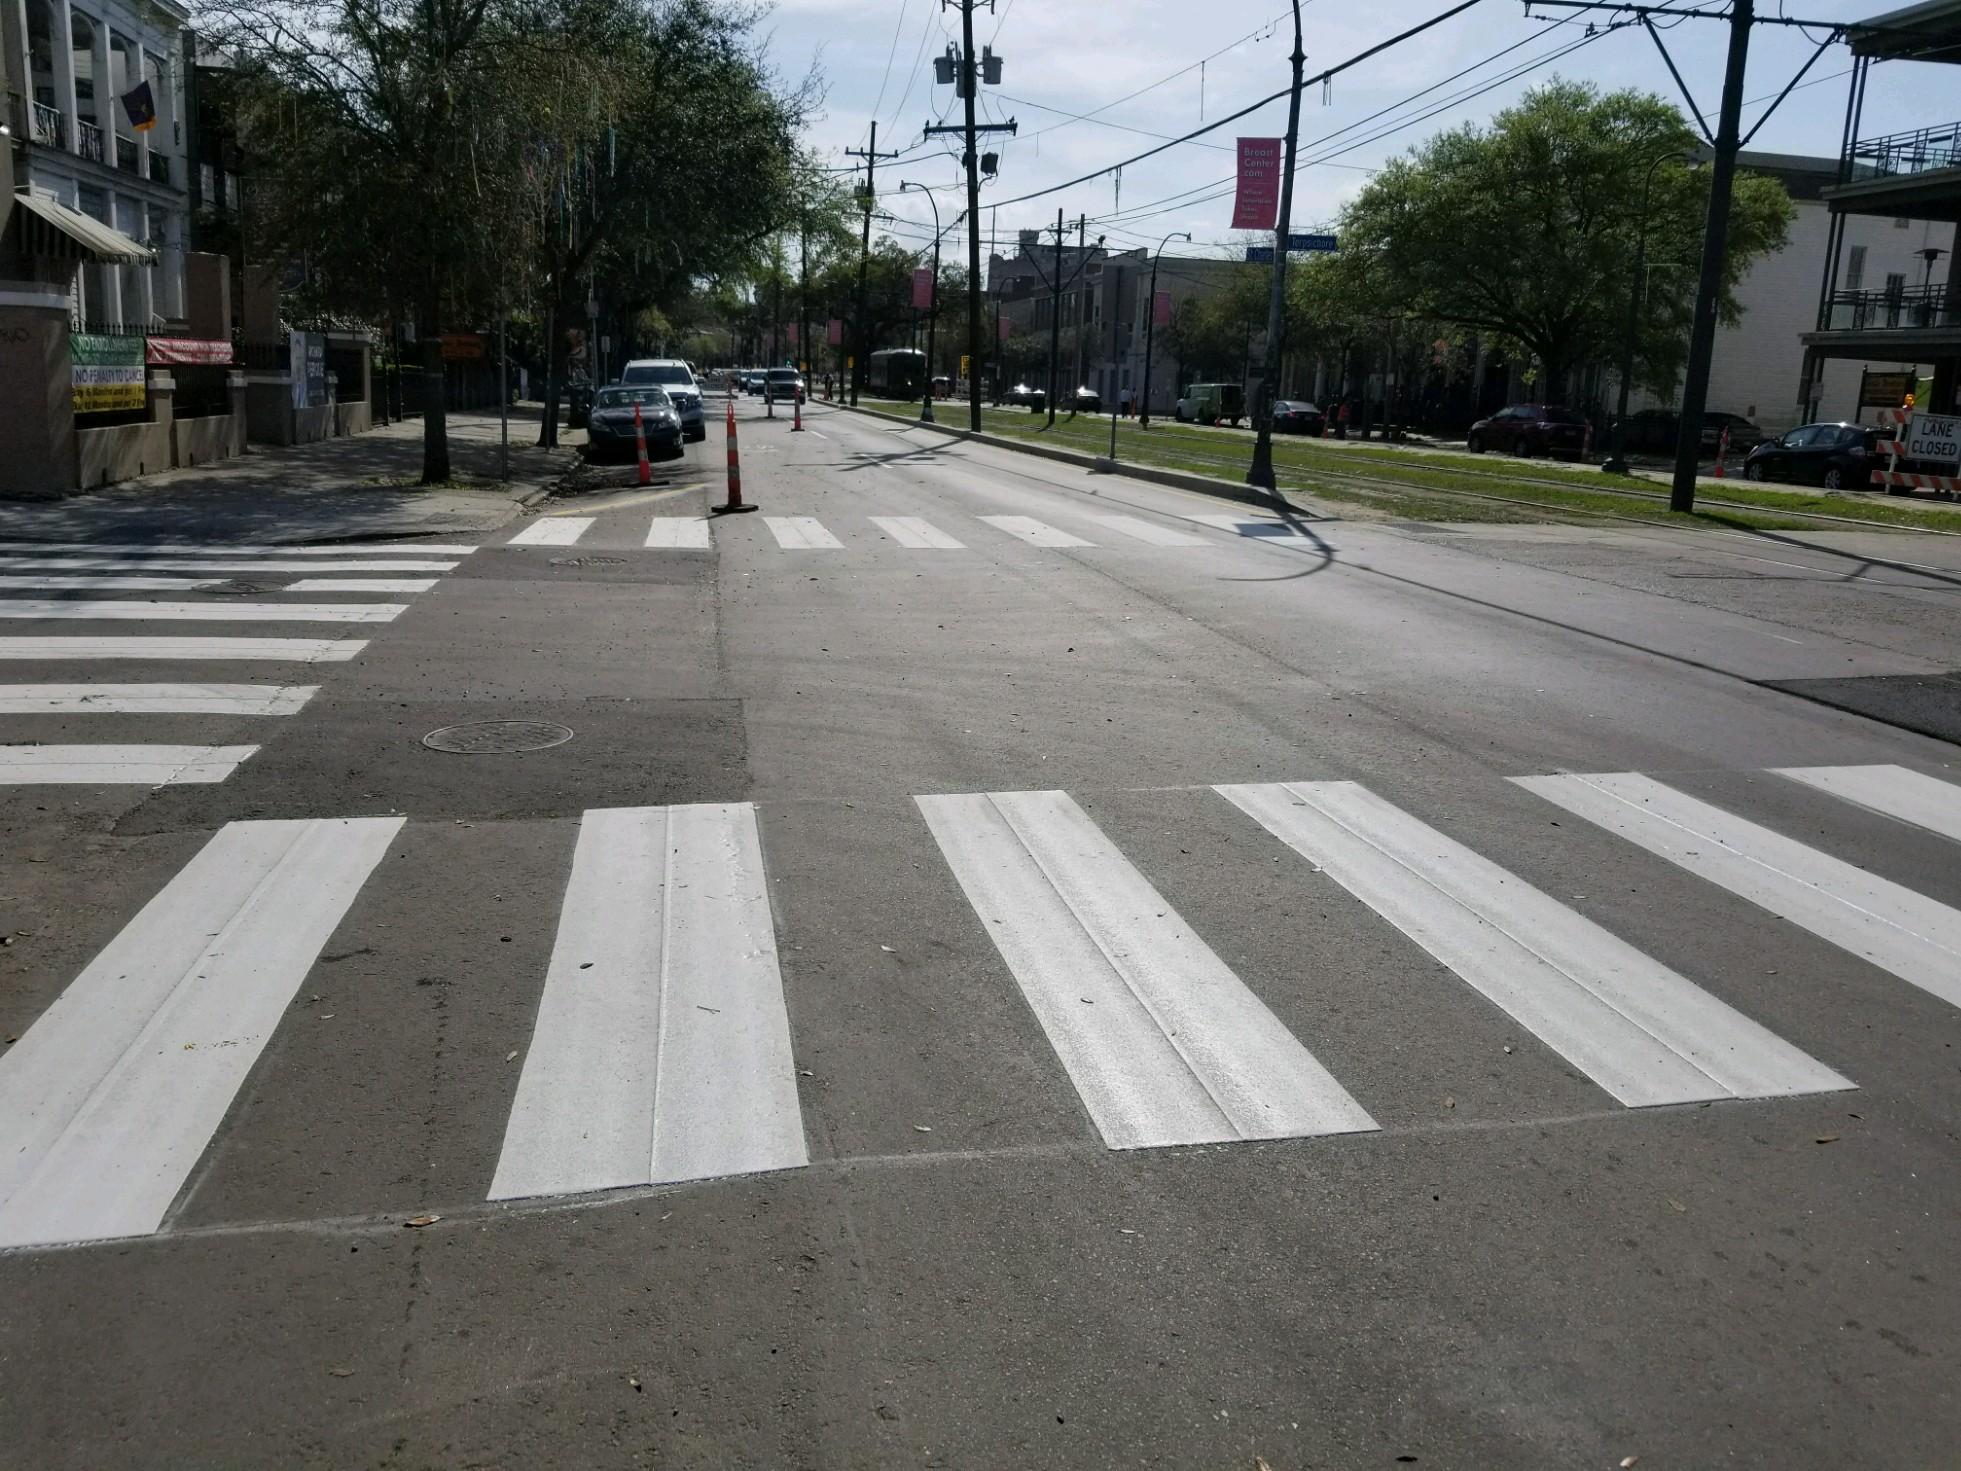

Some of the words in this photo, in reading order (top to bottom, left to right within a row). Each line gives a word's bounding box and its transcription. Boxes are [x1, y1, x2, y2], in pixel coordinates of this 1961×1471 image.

[1244, 147, 1274, 157] Breast
[1244, 159, 1274, 168] Center
[1292, 237, 1334, 248] Terpsichore
[78, 336, 90, 351] NO
[76, 369, 88, 383] NO
[90, 369, 114, 384] PENALTY
[115, 369, 123, 382] TO
[1921, 422, 1954, 437] LANE
[1912, 440, 1957, 457] CLOSED
